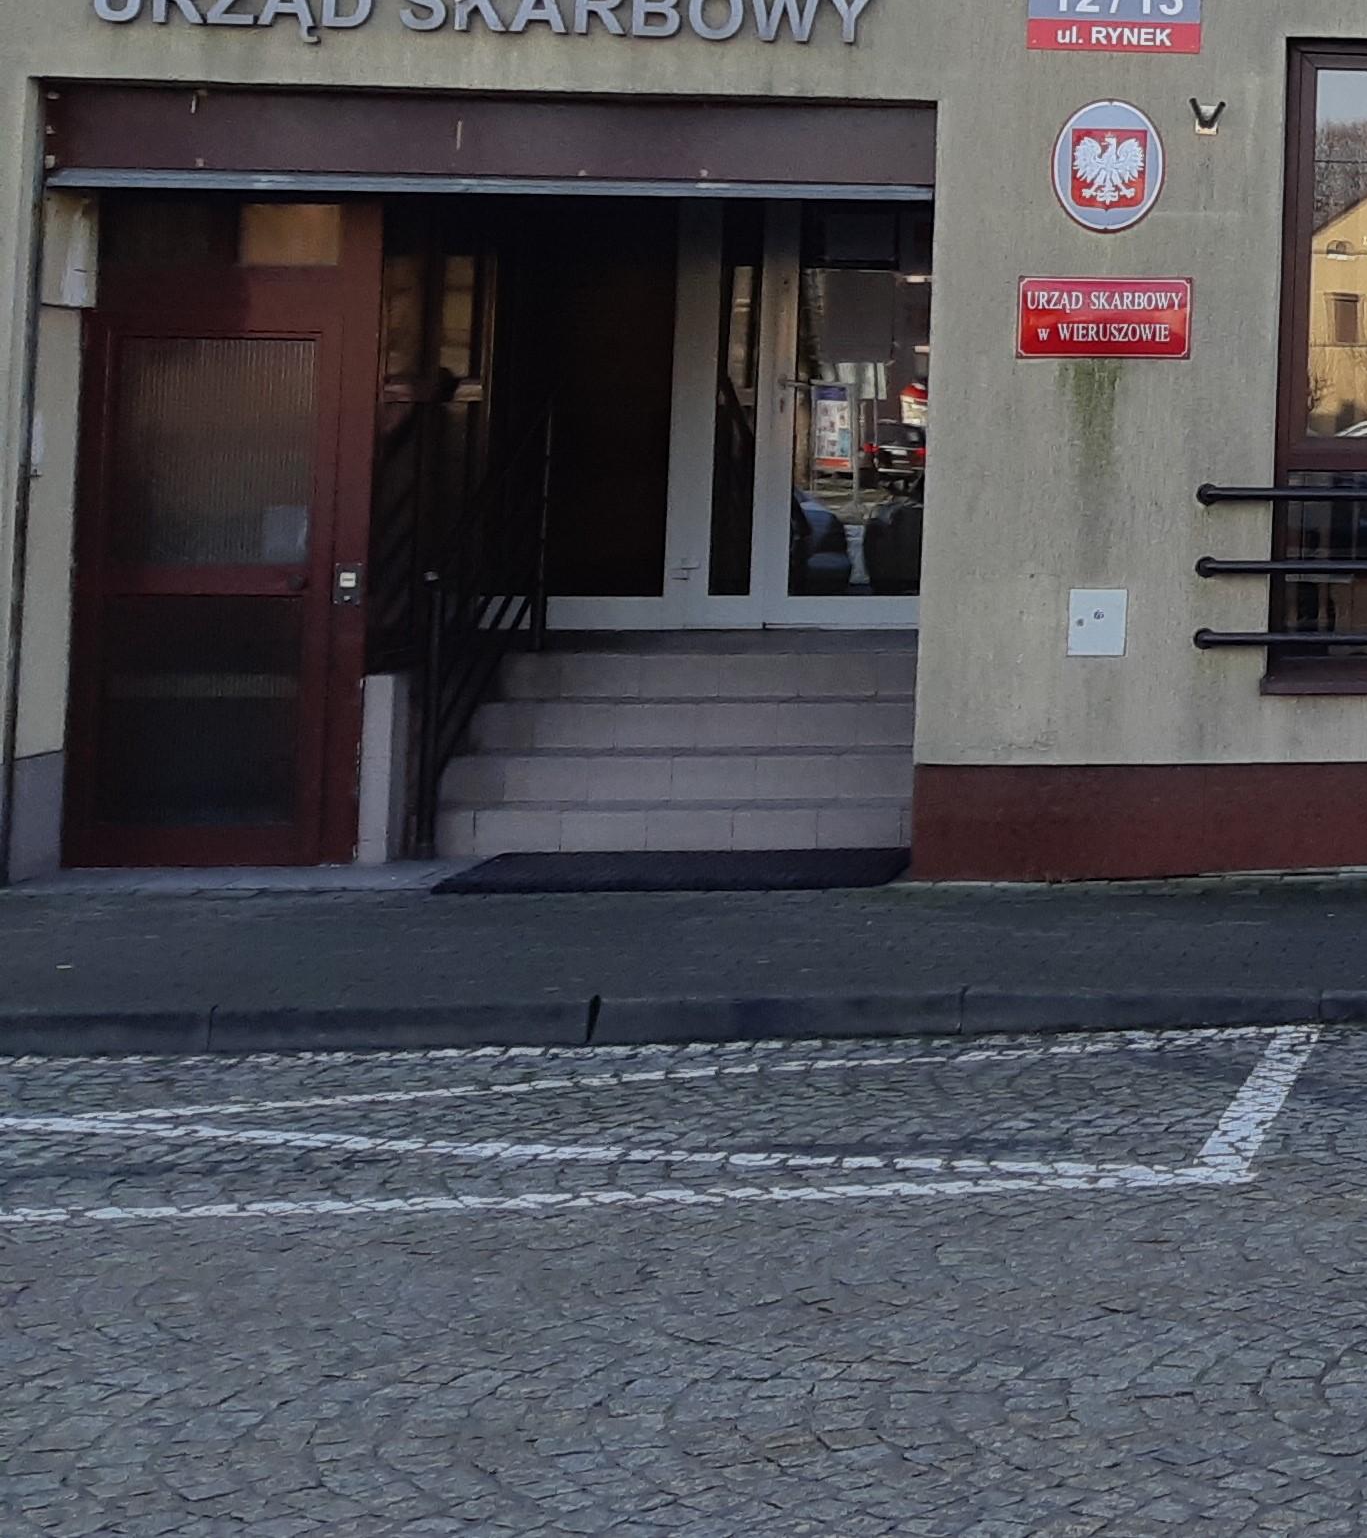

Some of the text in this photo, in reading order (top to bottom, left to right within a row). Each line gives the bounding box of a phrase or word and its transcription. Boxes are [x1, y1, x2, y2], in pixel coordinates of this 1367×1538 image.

[1056, 25, 1173, 47] ul. RYNEK
[1027, 290, 1183, 314] URZĄD SKARBOWY
[1037, 323, 1171, 343] w WIERUSZOWIE
